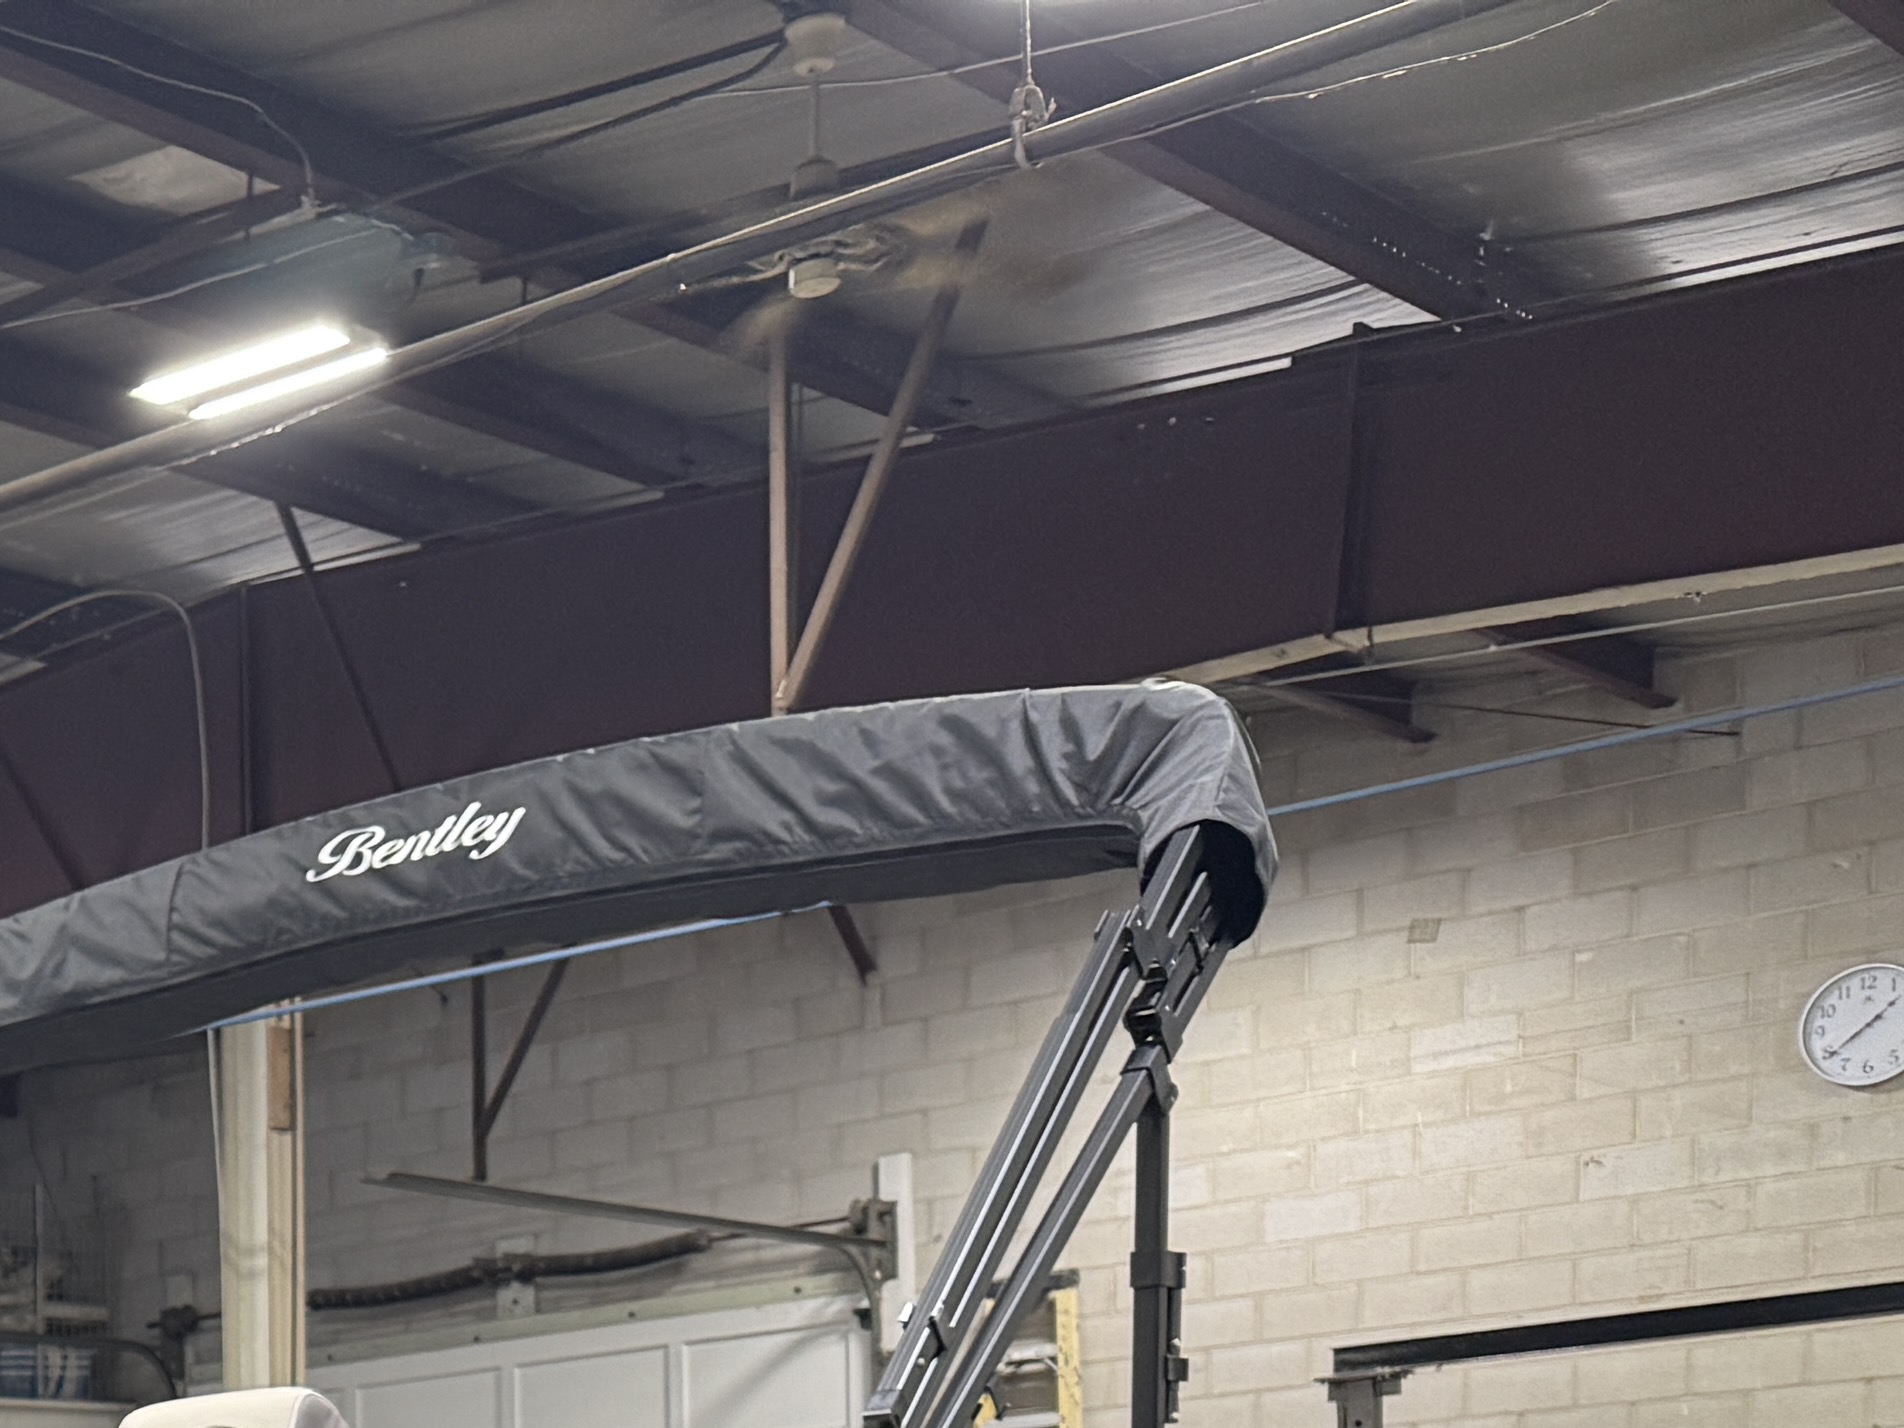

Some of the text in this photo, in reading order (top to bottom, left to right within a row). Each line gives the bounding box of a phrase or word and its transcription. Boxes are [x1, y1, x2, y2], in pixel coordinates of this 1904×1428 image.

[305, 800, 527, 883] Bentley
[1860, 975, 1878, 991] 12
[1837, 984, 1851, 1001] 11
[1819, 1003, 1837, 1019] 10
[1863, 1060, 1874, 1074] 6
